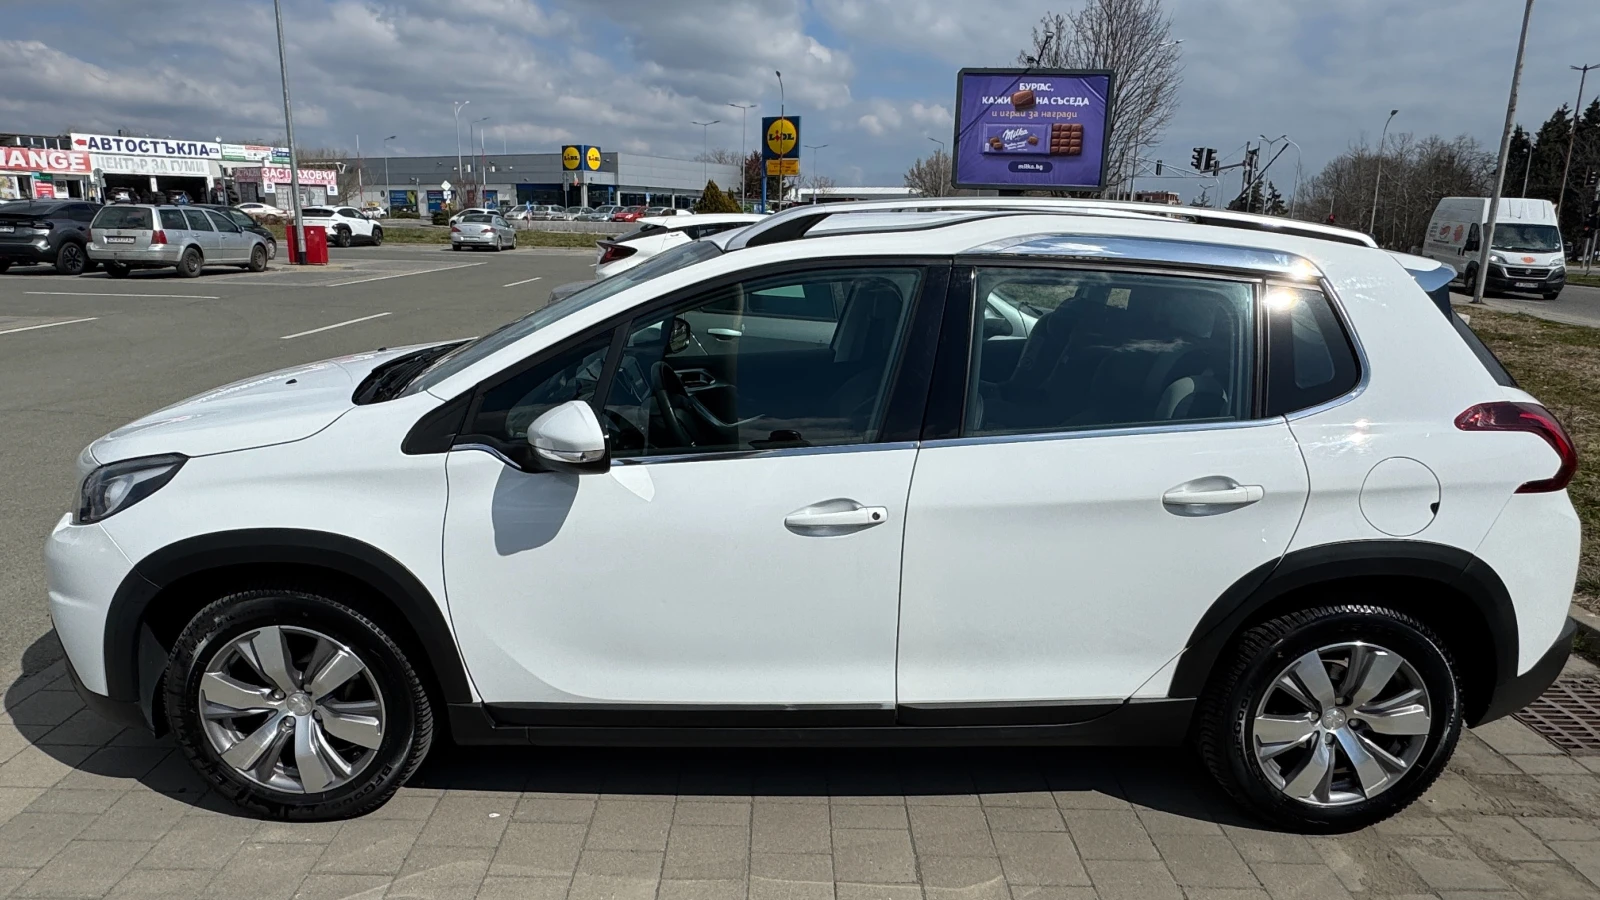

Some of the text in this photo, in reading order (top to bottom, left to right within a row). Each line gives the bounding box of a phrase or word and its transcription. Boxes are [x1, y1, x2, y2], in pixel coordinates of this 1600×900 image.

[1019, 83, 1054, 91] БУРГАС,
[982, 96, 1089, 106] КАЖИ НА СЪСЕДА
[1028, 111, 1038, 119] за
[1041, 111, 1077, 119] награди
[1002, 128, 1028, 140] Milka
[88, 137, 210, 156] АВТОСТЪКЛА
[96, 157, 205, 172] ЦЕНТЪР ЗА ГУМИ
[1018, 163, 1043, 171] milka.bg
[262, 168, 335, 181] ЗАСАХОВКИ
